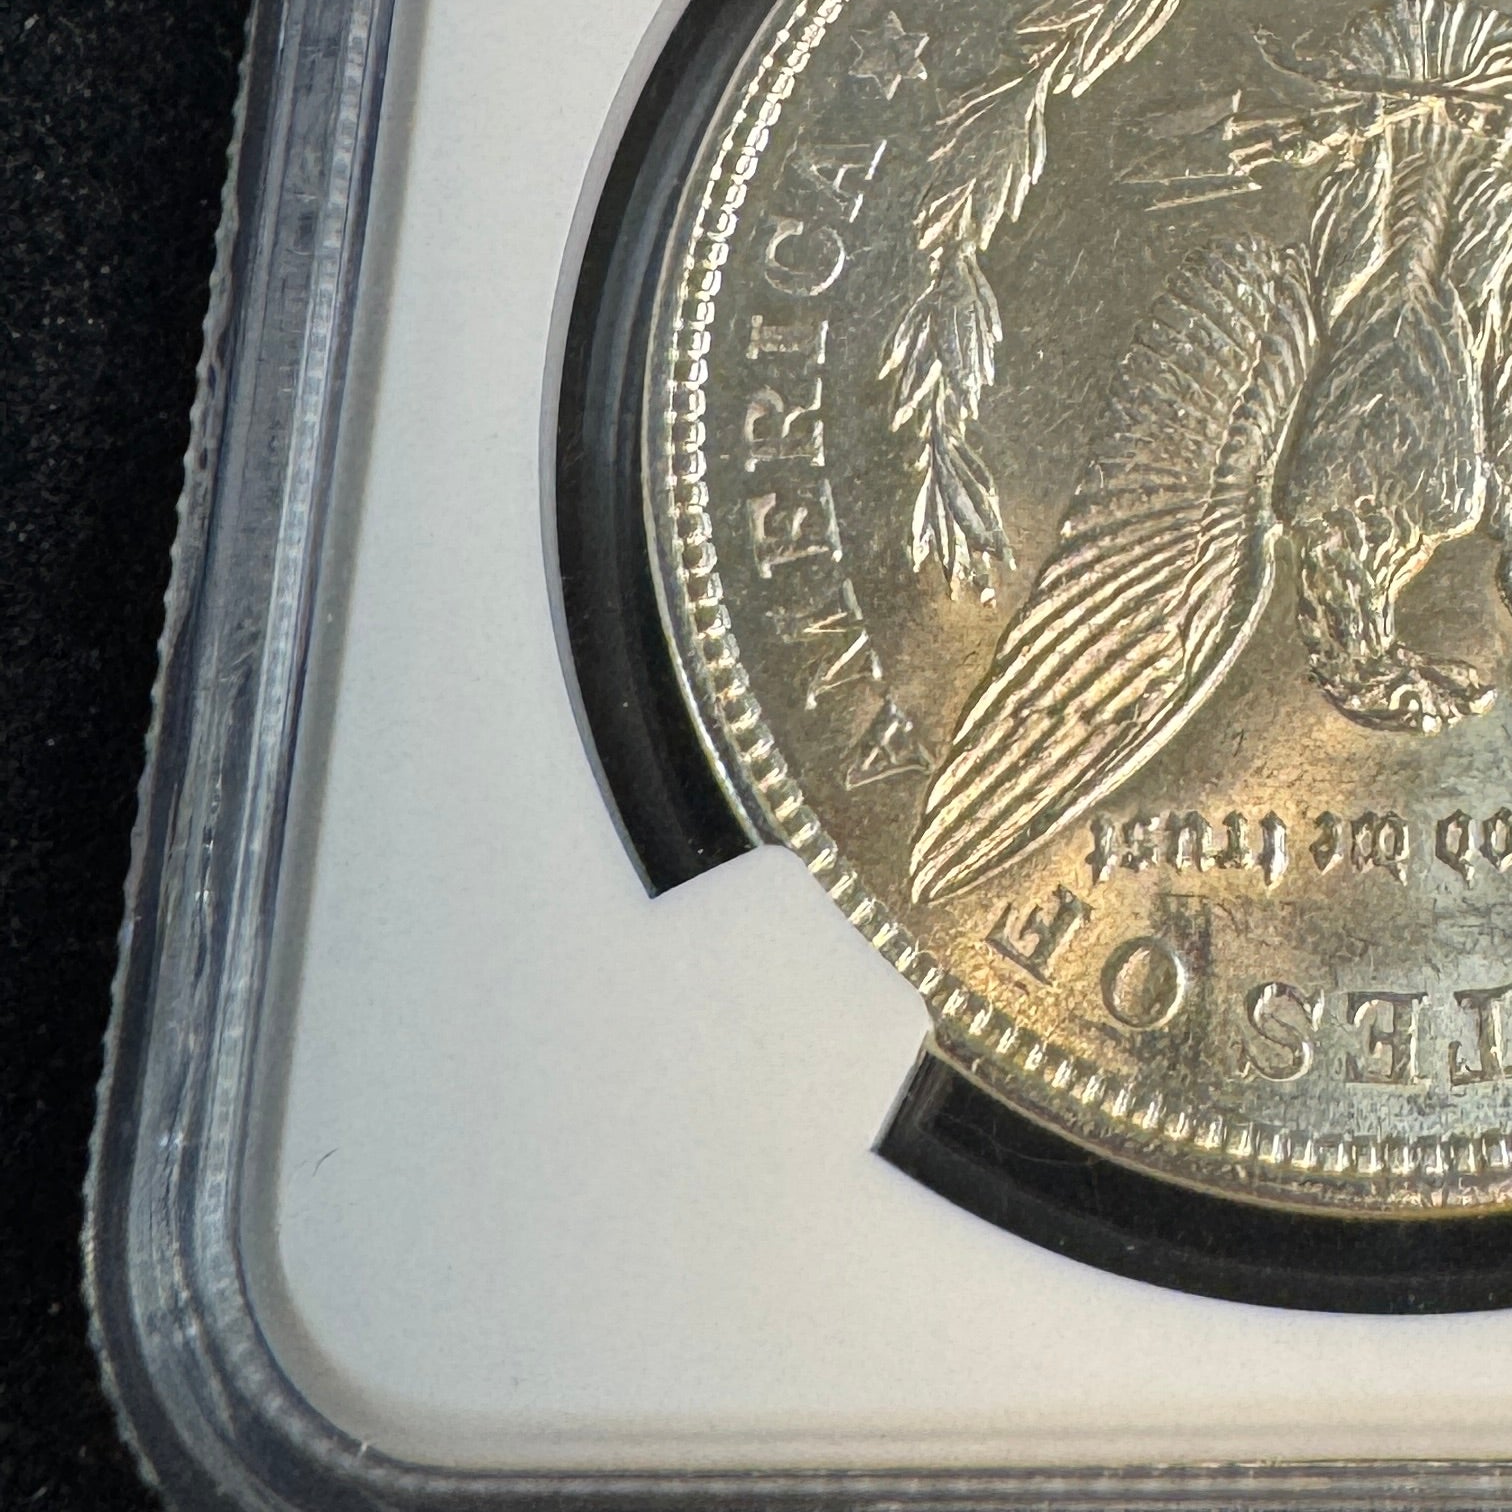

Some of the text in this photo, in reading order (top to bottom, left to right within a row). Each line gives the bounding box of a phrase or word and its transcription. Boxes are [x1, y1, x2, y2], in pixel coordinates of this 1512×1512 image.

[744, 138, 937, 789] AMERICA
[1085, 808, 1288, 889] trust
[986, 884, 1188, 1031] OF
